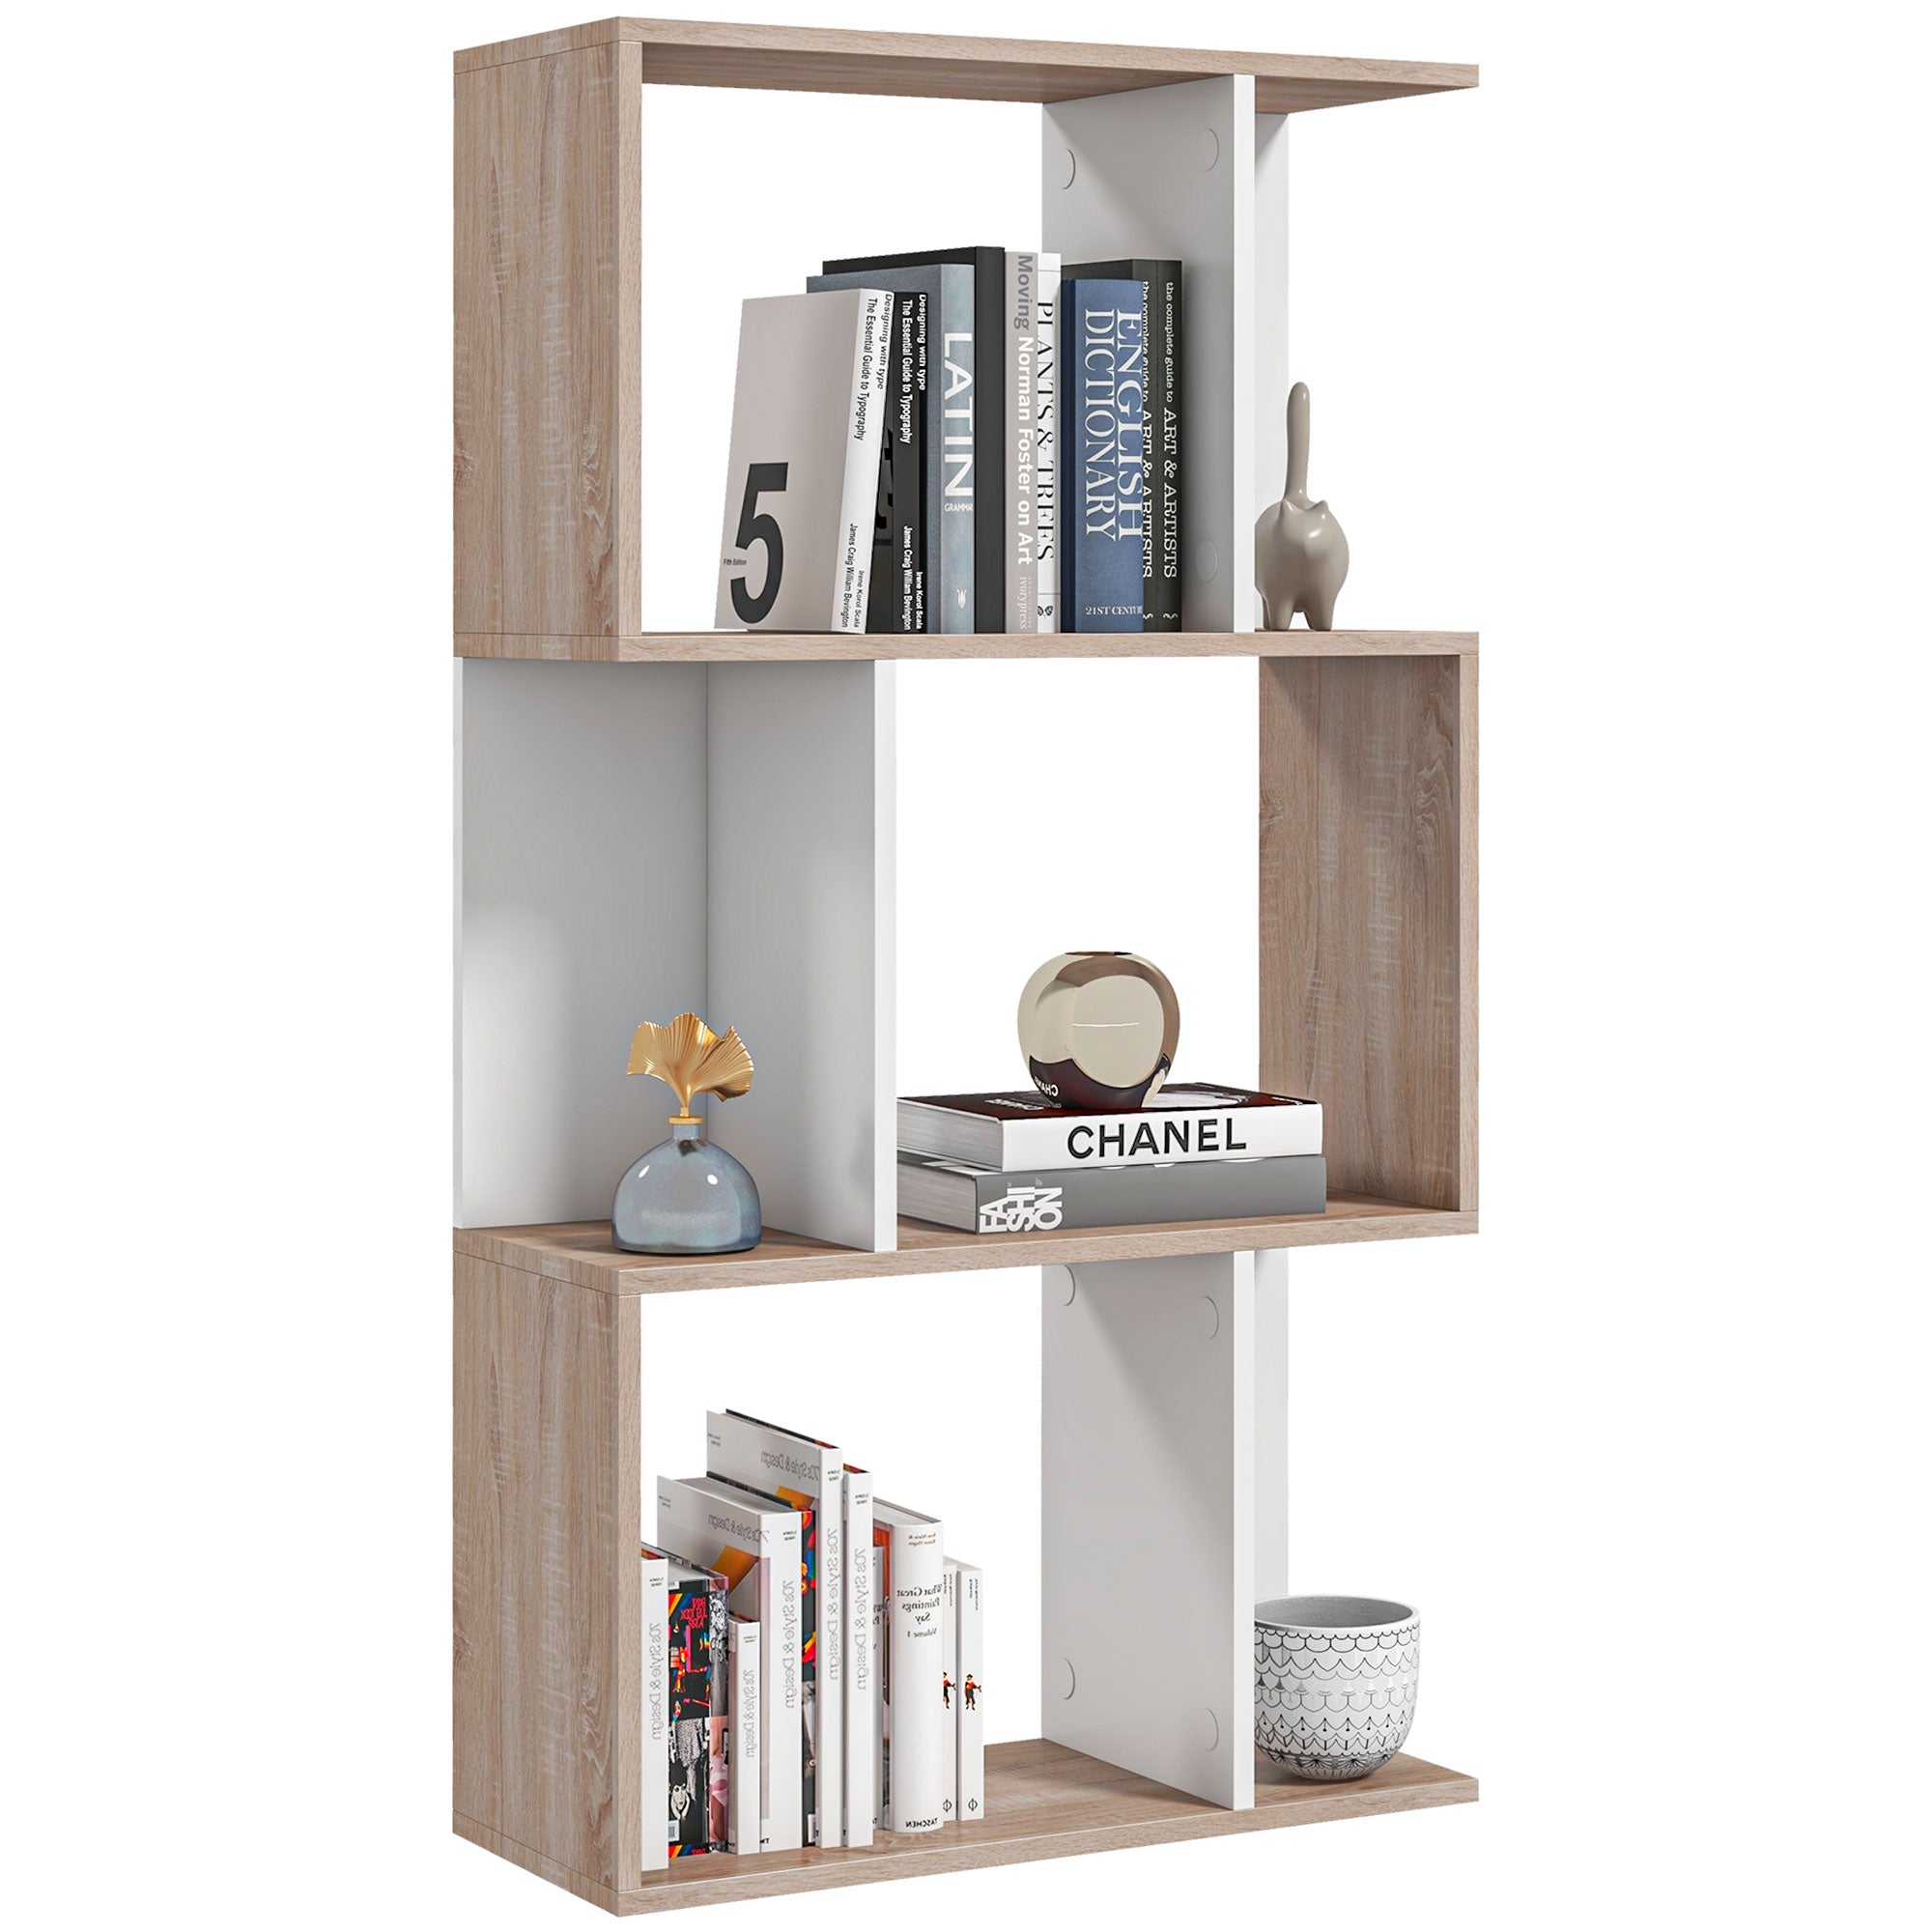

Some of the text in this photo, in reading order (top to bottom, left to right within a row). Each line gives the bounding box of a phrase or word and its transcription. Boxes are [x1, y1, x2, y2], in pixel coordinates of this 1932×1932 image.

[876, 294, 892, 389] Designing with type
[917, 294, 926, 344] Designing
[1165, 303, 1174, 355] complete
[854, 298, 878, 441] The Essential Guide to Typography
[899, 299, 913, 444] The Essential Guide to Typography
[917, 369, 926, 391] type
[1165, 356, 1174, 388] guide
[944, 332, 974, 497] LATIN
[1014, 255, 1034, 565] Moving Norman Foster on Art
[1166, 390, 1173, 403] to
[1037, 428, 1054, 451] &
[1084, 308, 1117, 542] DICTIONARY
[1117, 308, 1144, 541] ENGLISH
[1164, 407, 1177, 455] ART
[1164, 459, 1178, 479] &
[1037, 460, 1054, 560] TREES
[1164, 482, 1178, 579] ARTISTS
[730, 462, 789, 624] 5
[901, 549, 913, 569] Craig
[902, 525, 913, 548] James
[840, 524, 859, 628] James Craig William Bevington
[856, 587, 865, 610] Korol
[903, 569, 913, 594] William
[854, 610, 863, 628] Scala
[1085, 606, 1111, 615] 21ST
[1067, 1117, 1247, 1159] CHANEL
